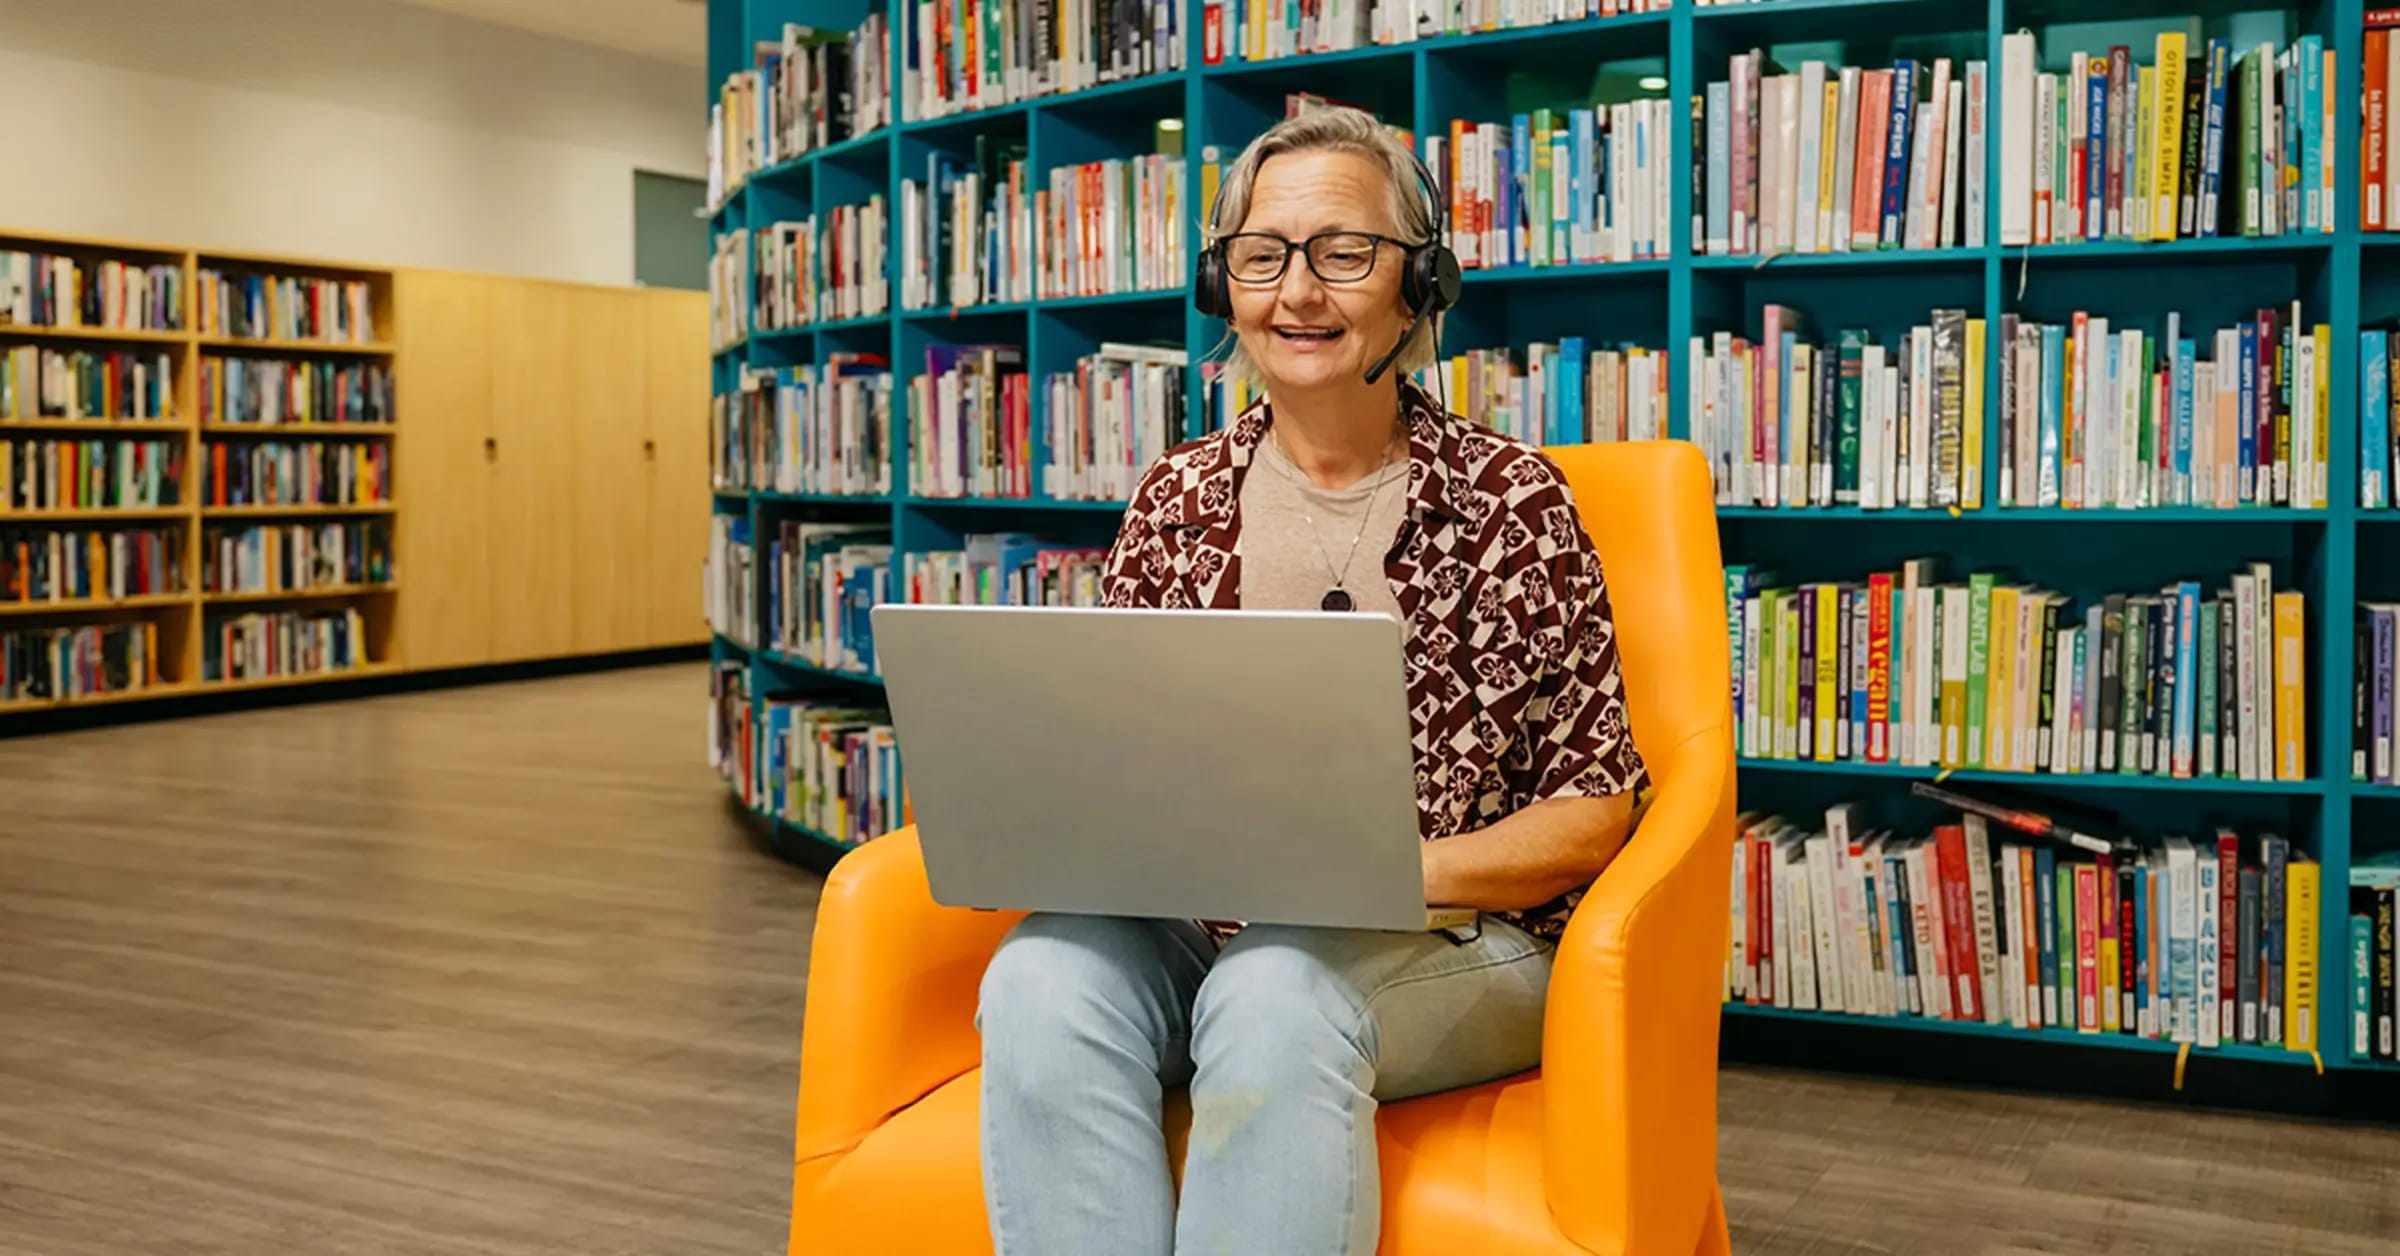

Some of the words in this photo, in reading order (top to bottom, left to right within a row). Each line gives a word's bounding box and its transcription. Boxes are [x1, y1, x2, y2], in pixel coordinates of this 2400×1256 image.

[1896, 68, 1909, 109] BRENT
[2163, 50, 2178, 141] OTTOLENGHI
[2159, 147, 2172, 196] SIMPLE
[1970, 583, 1988, 675] PLANTLAB
[1914, 902, 1930, 945] KETO
[1974, 889, 1996, 977] EVERYDA
